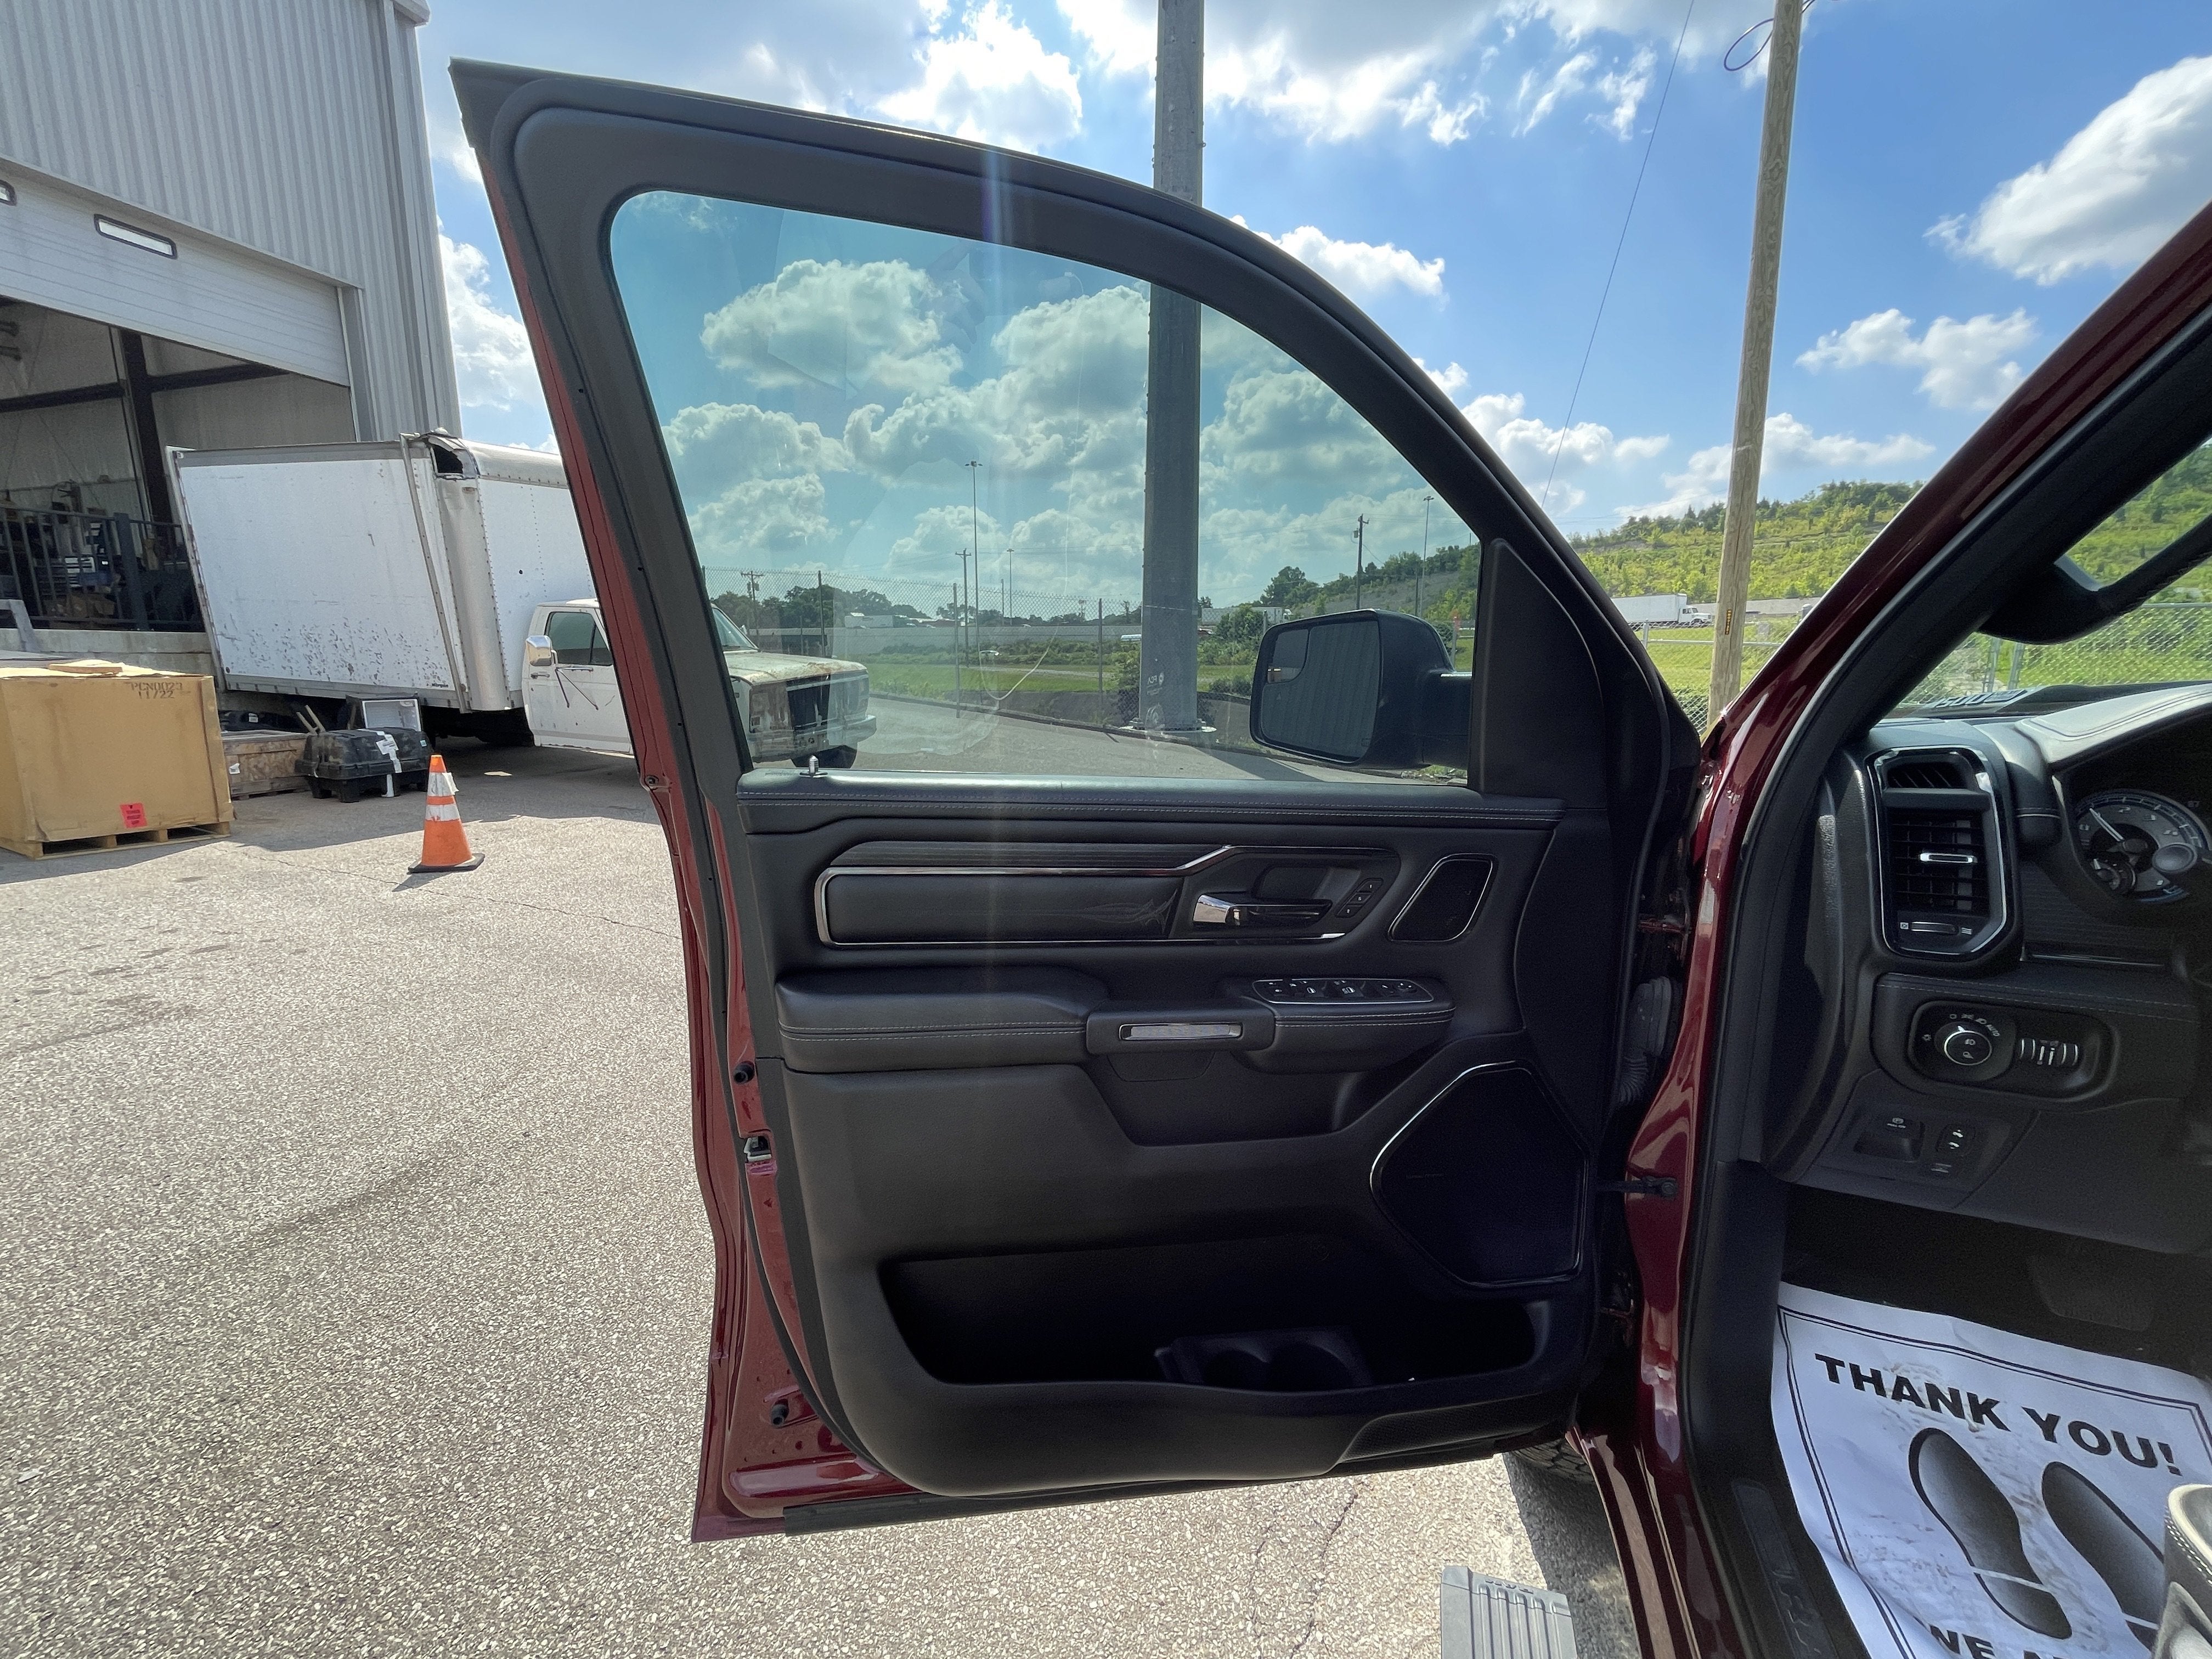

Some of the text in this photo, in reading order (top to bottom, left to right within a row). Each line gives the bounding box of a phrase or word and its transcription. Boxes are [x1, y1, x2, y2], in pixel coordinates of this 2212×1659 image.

[138, 690, 175, 699] 11/22
[1986, 1024, 2000, 1037] AUTO
[1814, 1353, 2183, 1476] THANK YOU!
